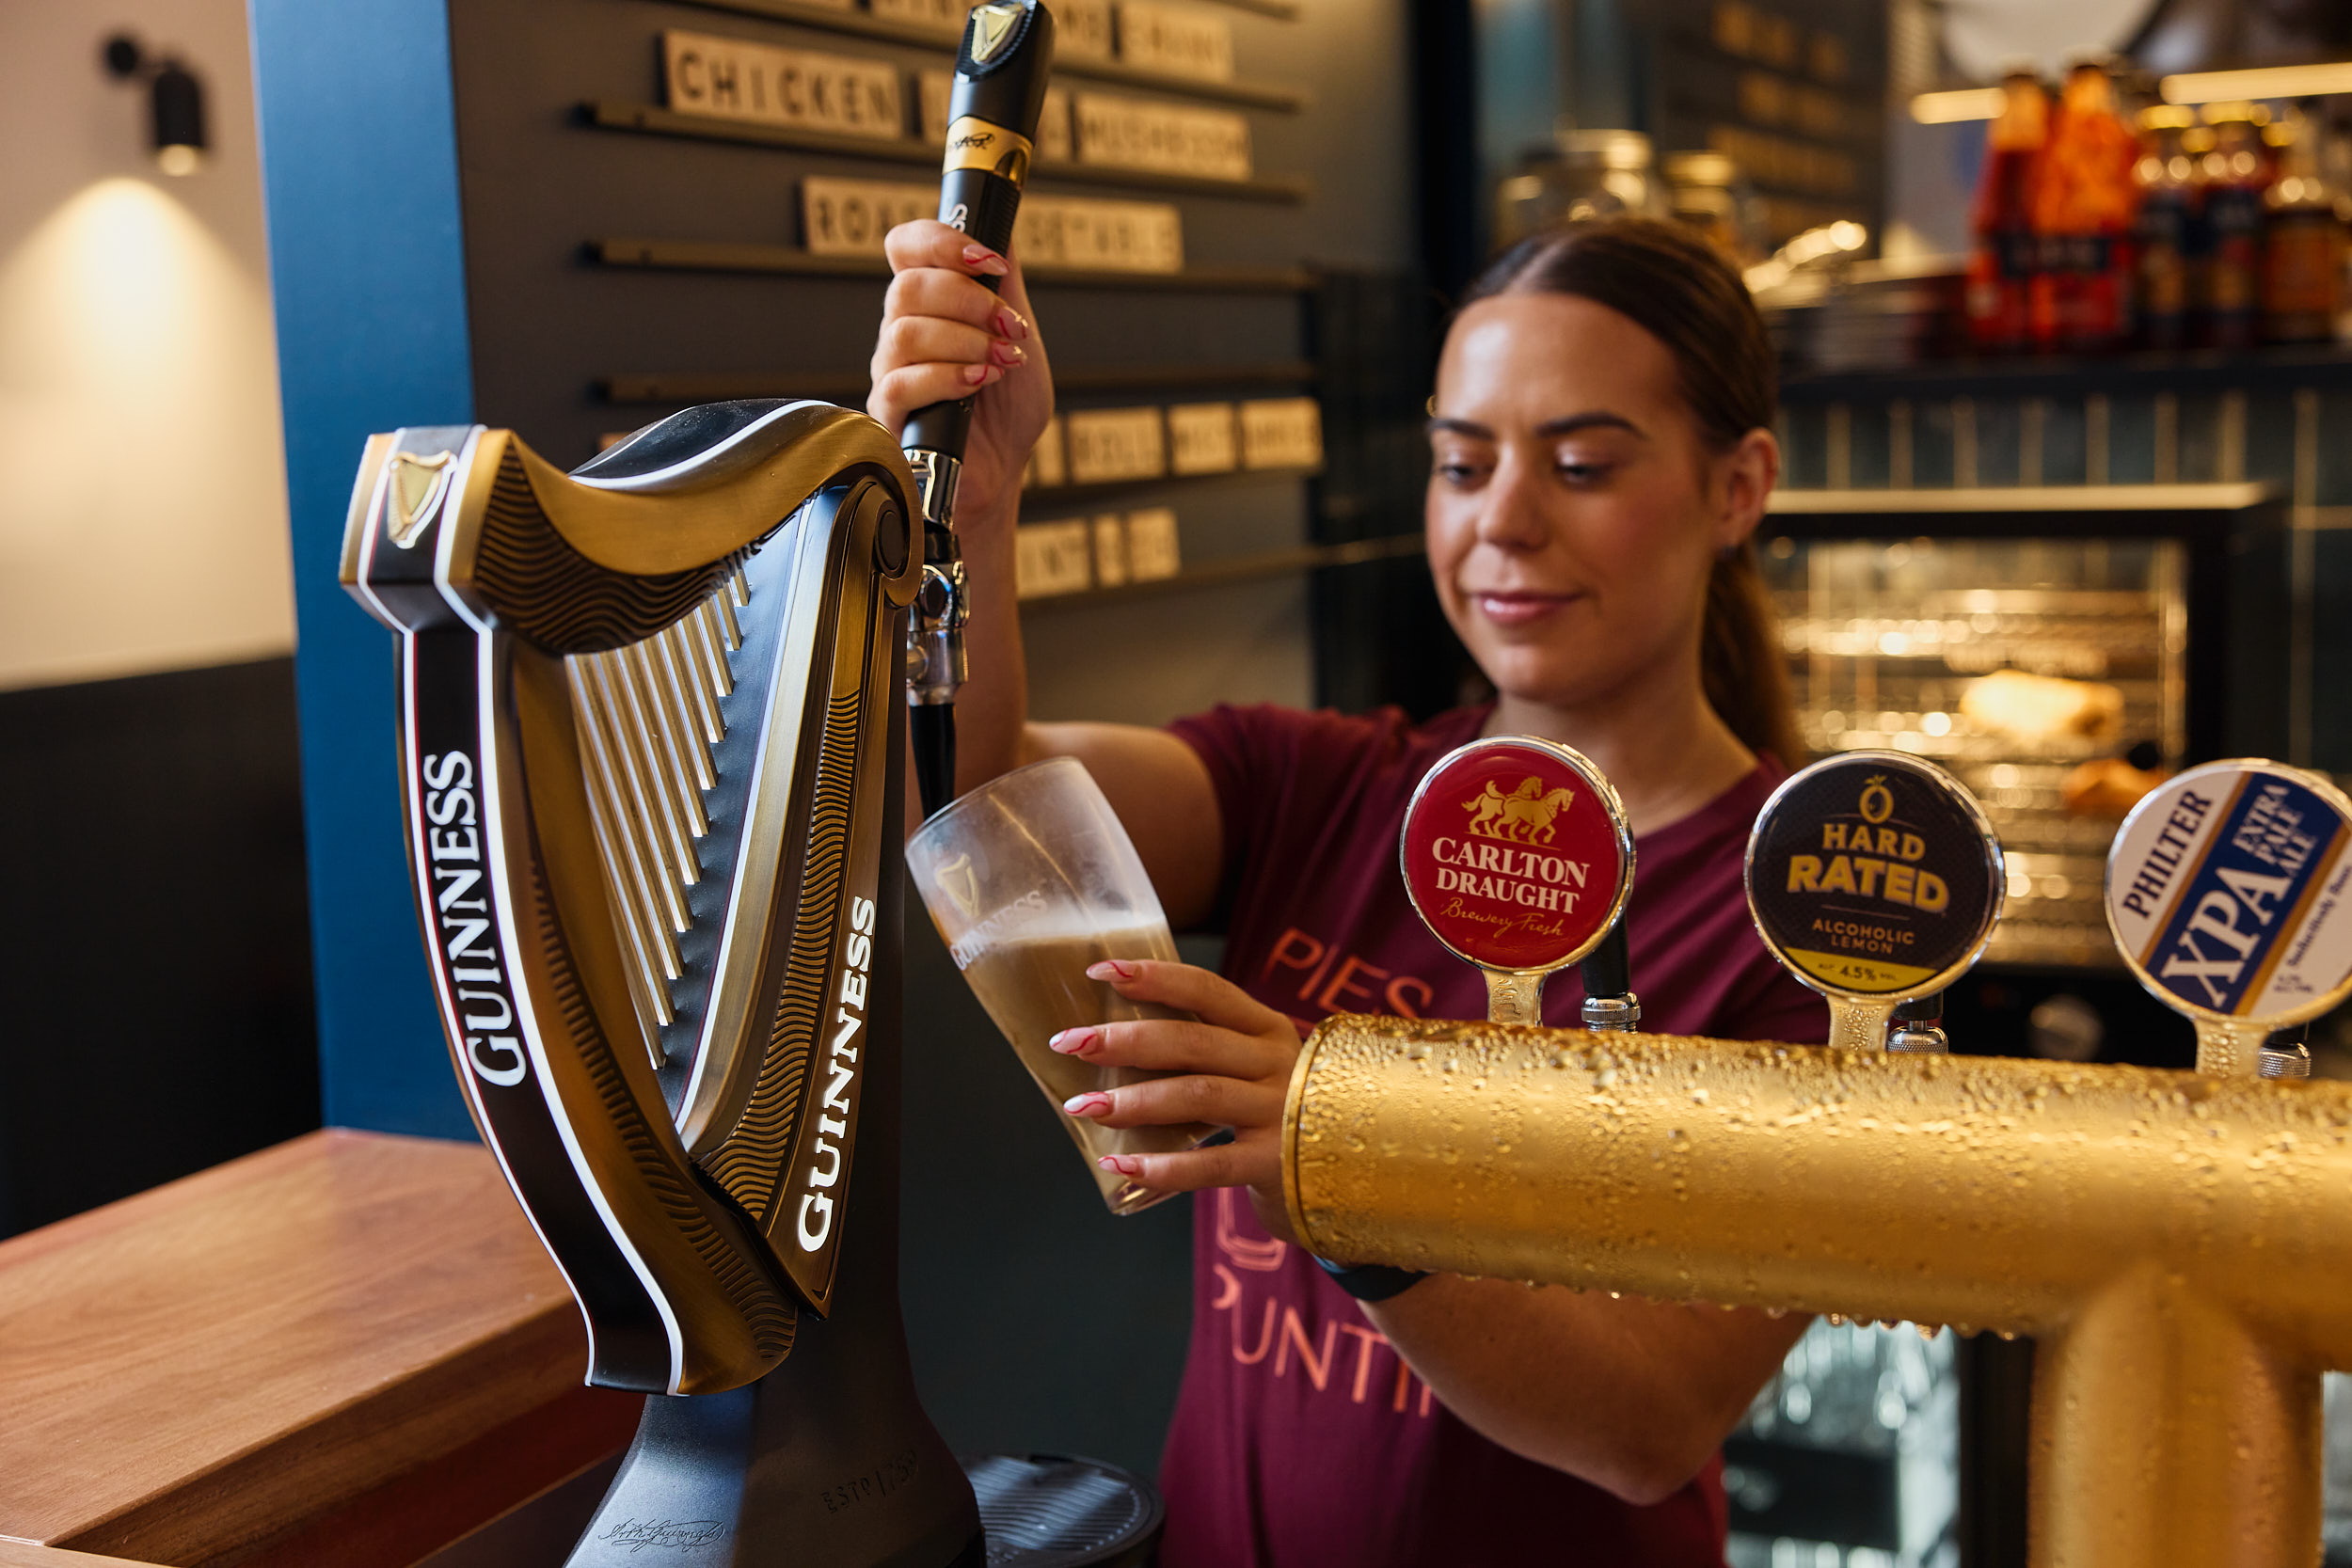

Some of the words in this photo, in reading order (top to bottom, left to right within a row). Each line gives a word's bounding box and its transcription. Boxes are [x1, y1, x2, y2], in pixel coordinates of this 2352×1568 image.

[675, 50, 896, 124] CHICKEN
[1431, 836, 1591, 889] CARLTON
[1822, 823, 1925, 861] HARD
[2122, 790, 2214, 920] PHILTER
[1435, 867, 1580, 915] DRAUGHT
[1786, 854, 1950, 914] RATED
[423, 750, 527, 1086] GUINNESS
[1439, 896, 1515, 939] Brewery
[1516, 912, 1564, 936] Fresh
[1812, 918, 1915, 944] ALCOHOLIC
[1831, 934, 1893, 954] LEMON
[2161, 866, 2296, 1008] XPA
[1839, 965, 1879, 982] 4.5%
[798, 895, 876, 1253] GUINNESS
